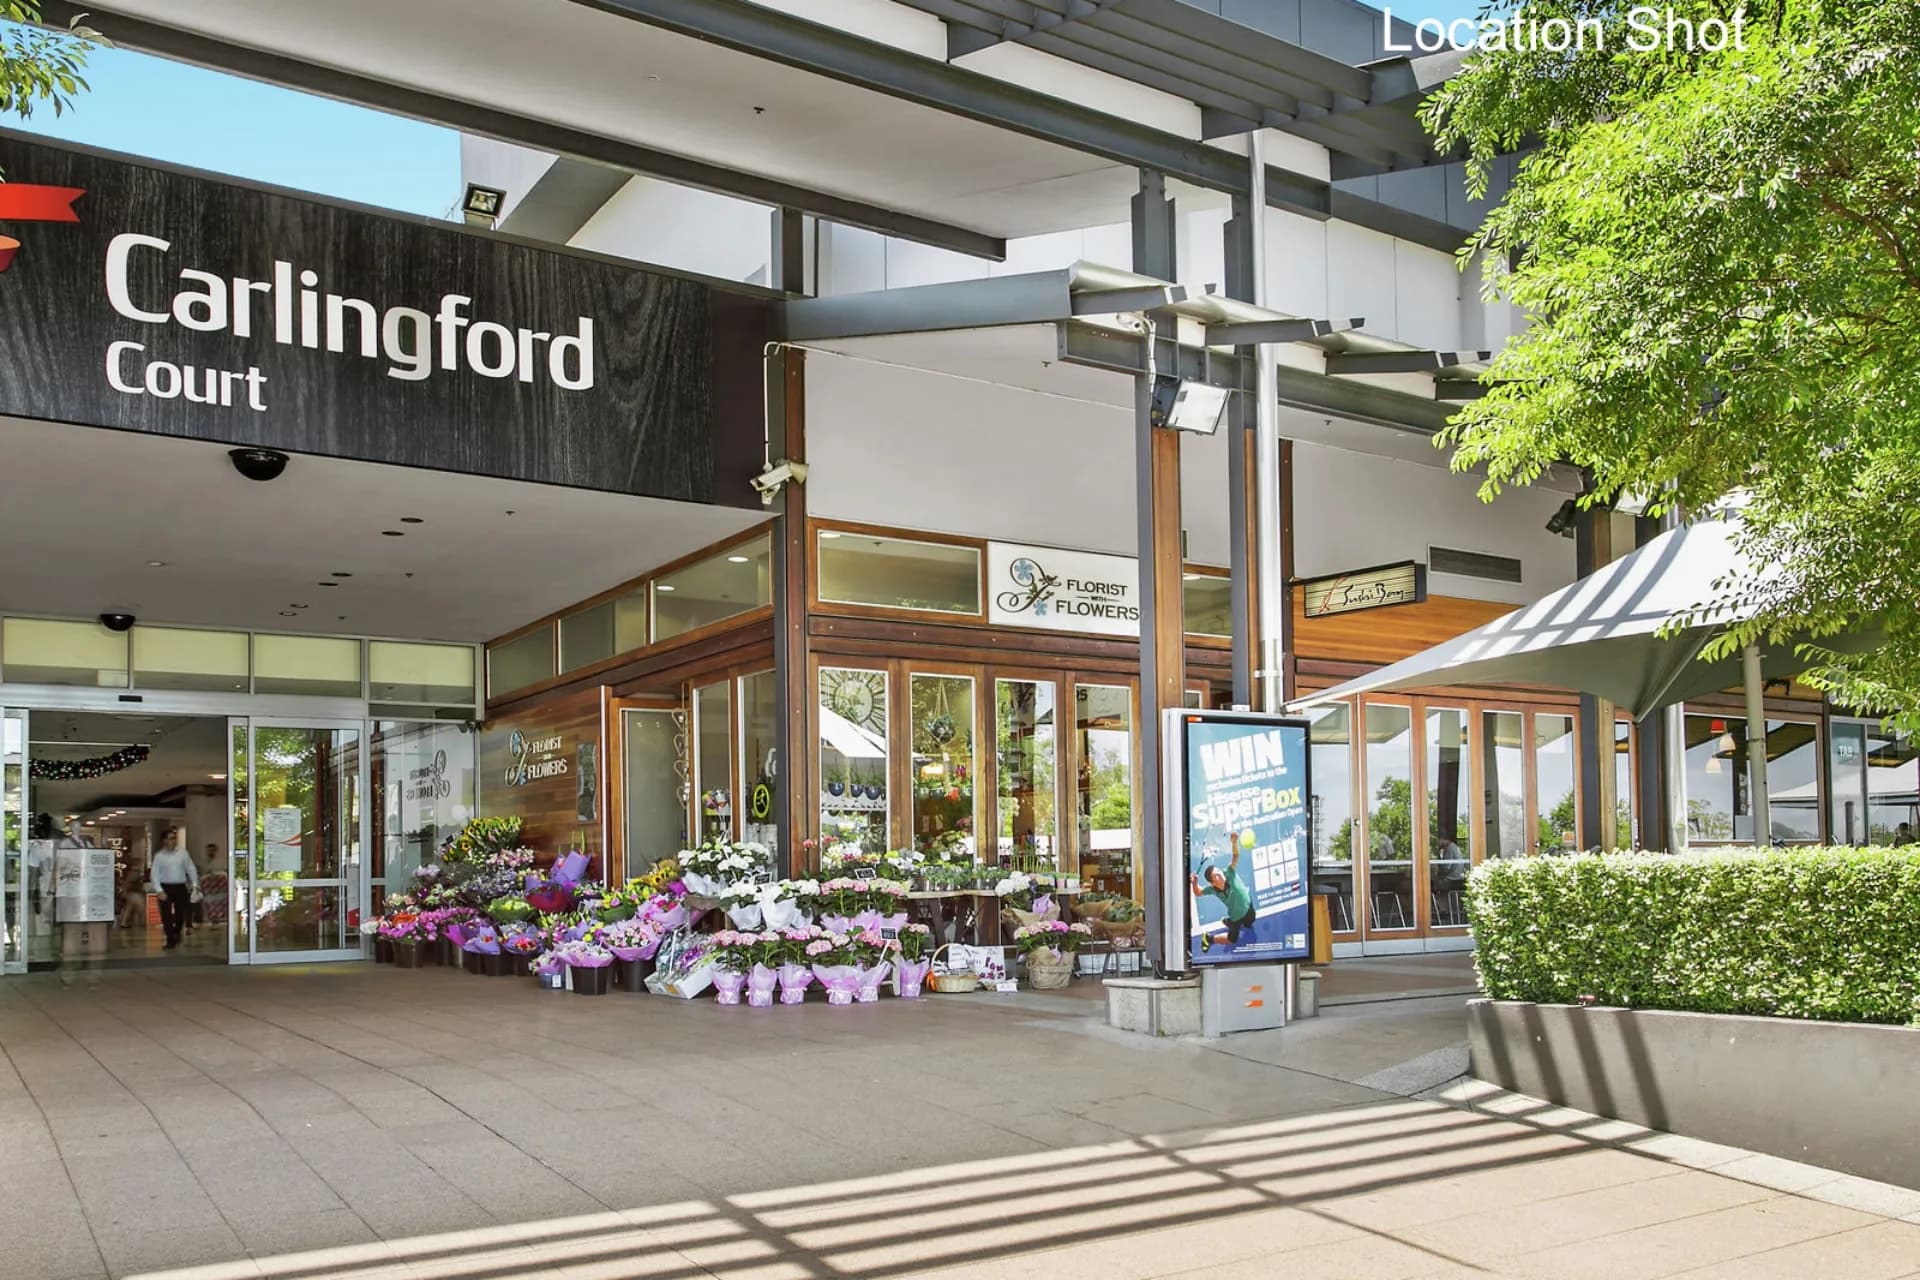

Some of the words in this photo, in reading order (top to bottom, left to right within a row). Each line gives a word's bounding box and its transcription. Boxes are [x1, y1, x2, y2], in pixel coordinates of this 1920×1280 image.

[105, 233, 594, 390] Carlingford
[105, 340, 268, 411] Court
[1067, 579, 1128, 596] FLORIST
[1343, 584, 1374, 606] Sushi
[1056, 600, 1139, 620] FLOWERS
[533, 736, 562, 753] FLORIST
[1200, 730, 1284, 781] WIN
[528, 759, 568, 779] FLOWERS
[1193, 786, 1301, 832] SuperBox
